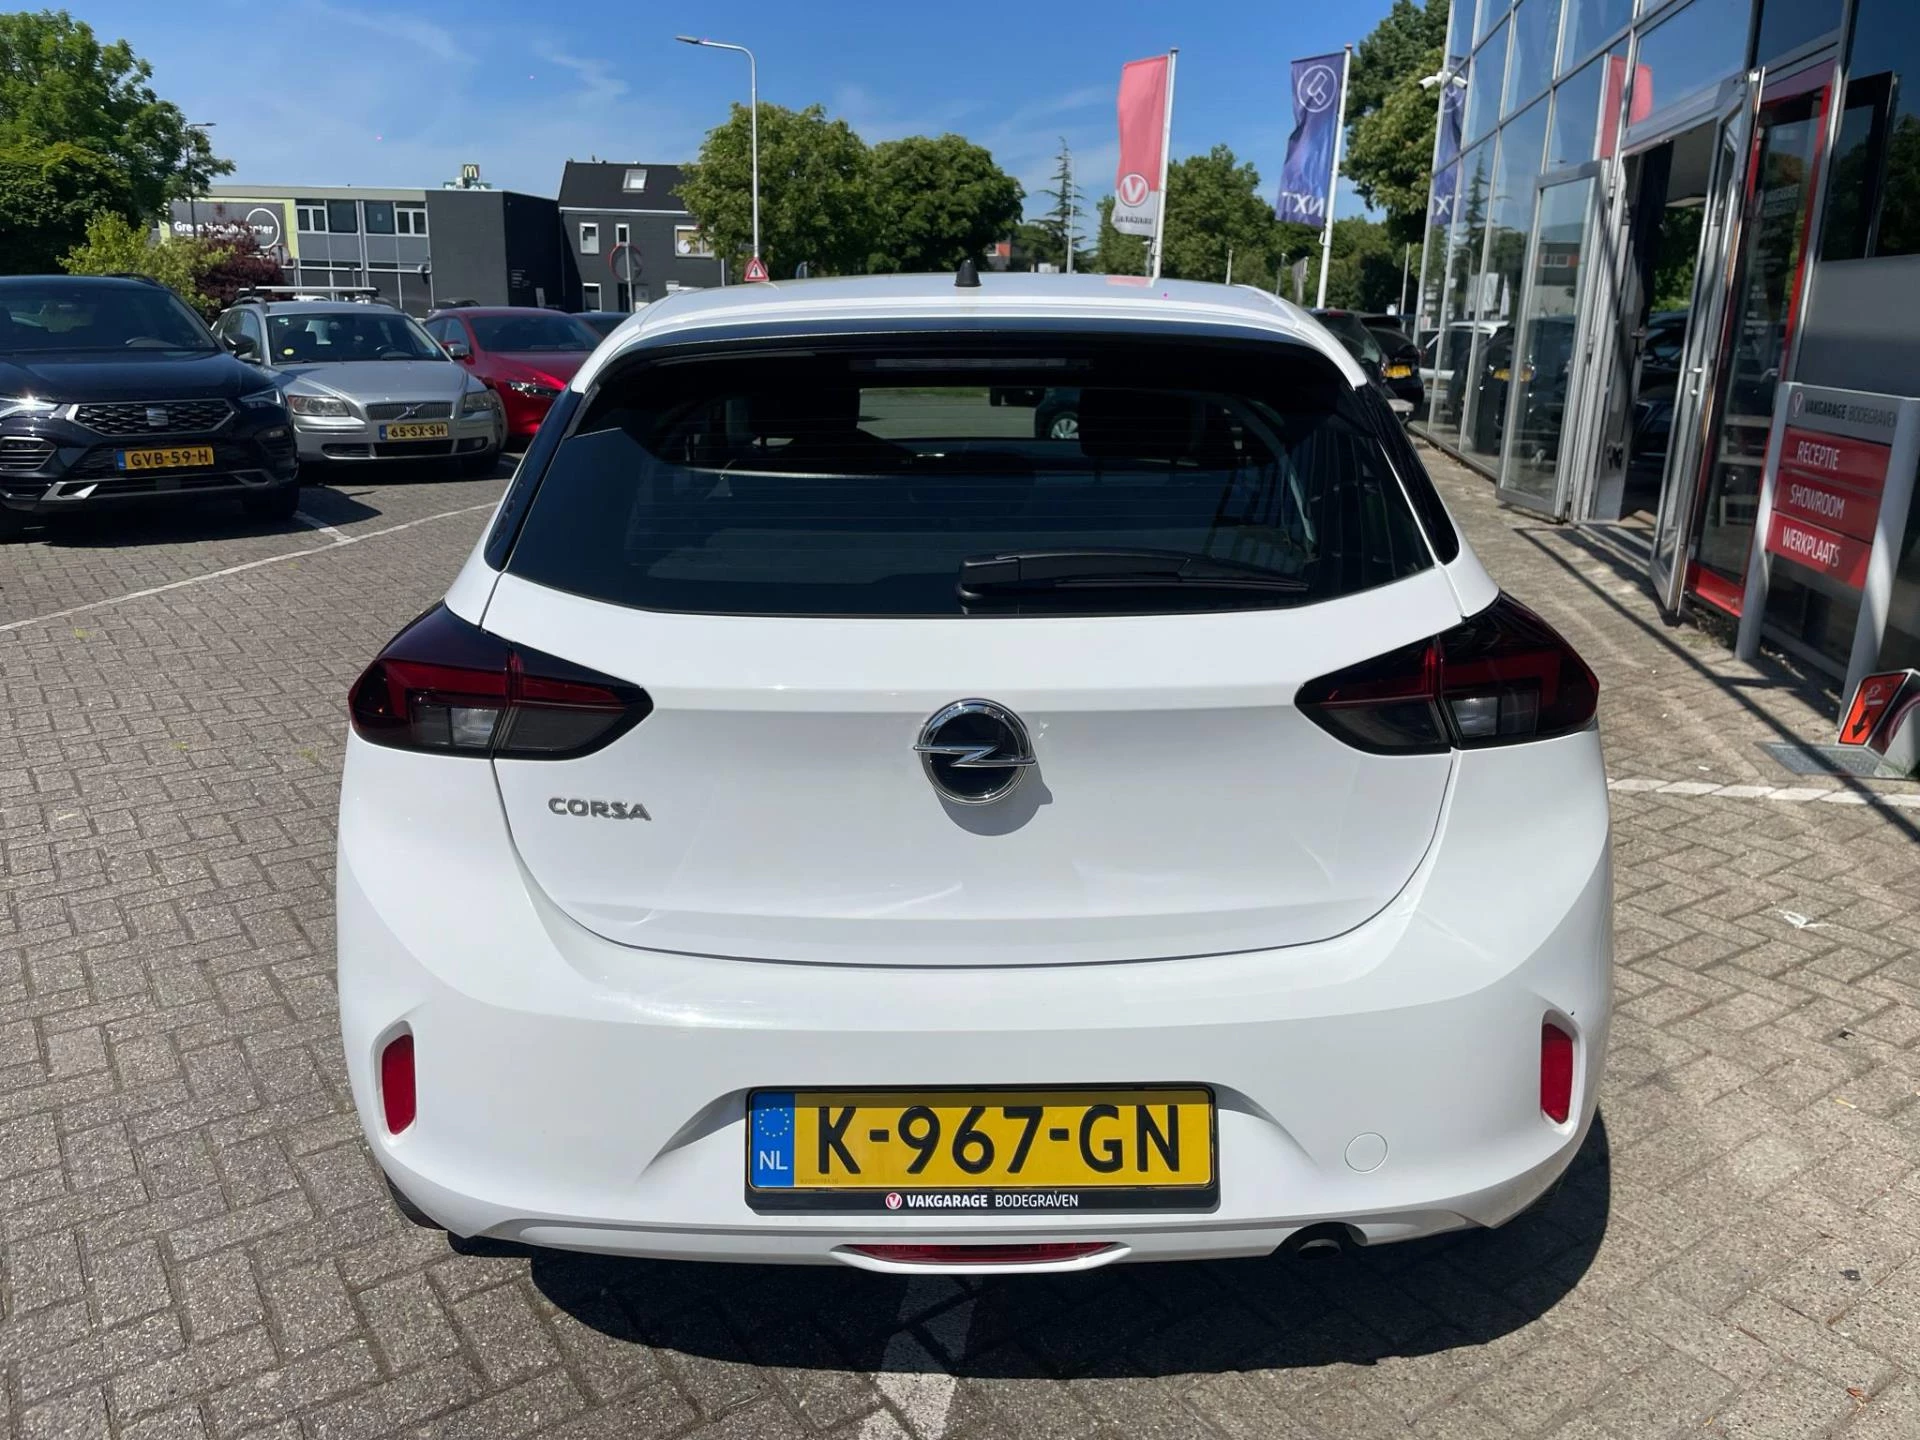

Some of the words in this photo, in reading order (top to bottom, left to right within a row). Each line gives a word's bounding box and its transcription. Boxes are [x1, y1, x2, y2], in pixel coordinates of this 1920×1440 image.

[174, 221, 204, 232] Gren
[391, 424, 445, 438] 65-SX-SH
[131, 449, 208, 466] GVB-59-H
[1797, 441, 1840, 470] RECEPTIE
[1790, 484, 1845, 519] SHOWROOM
[1782, 526, 1840, 567] WERKPLAATS
[548, 798, 652, 821] CORSA
[818, 1104, 1180, 1175] K-967-GN
[759, 1150, 788, 1170] NL
[907, 1194, 988, 1208] VAKGARAGE
[995, 1194, 1079, 1208] BODEGRAVEN
